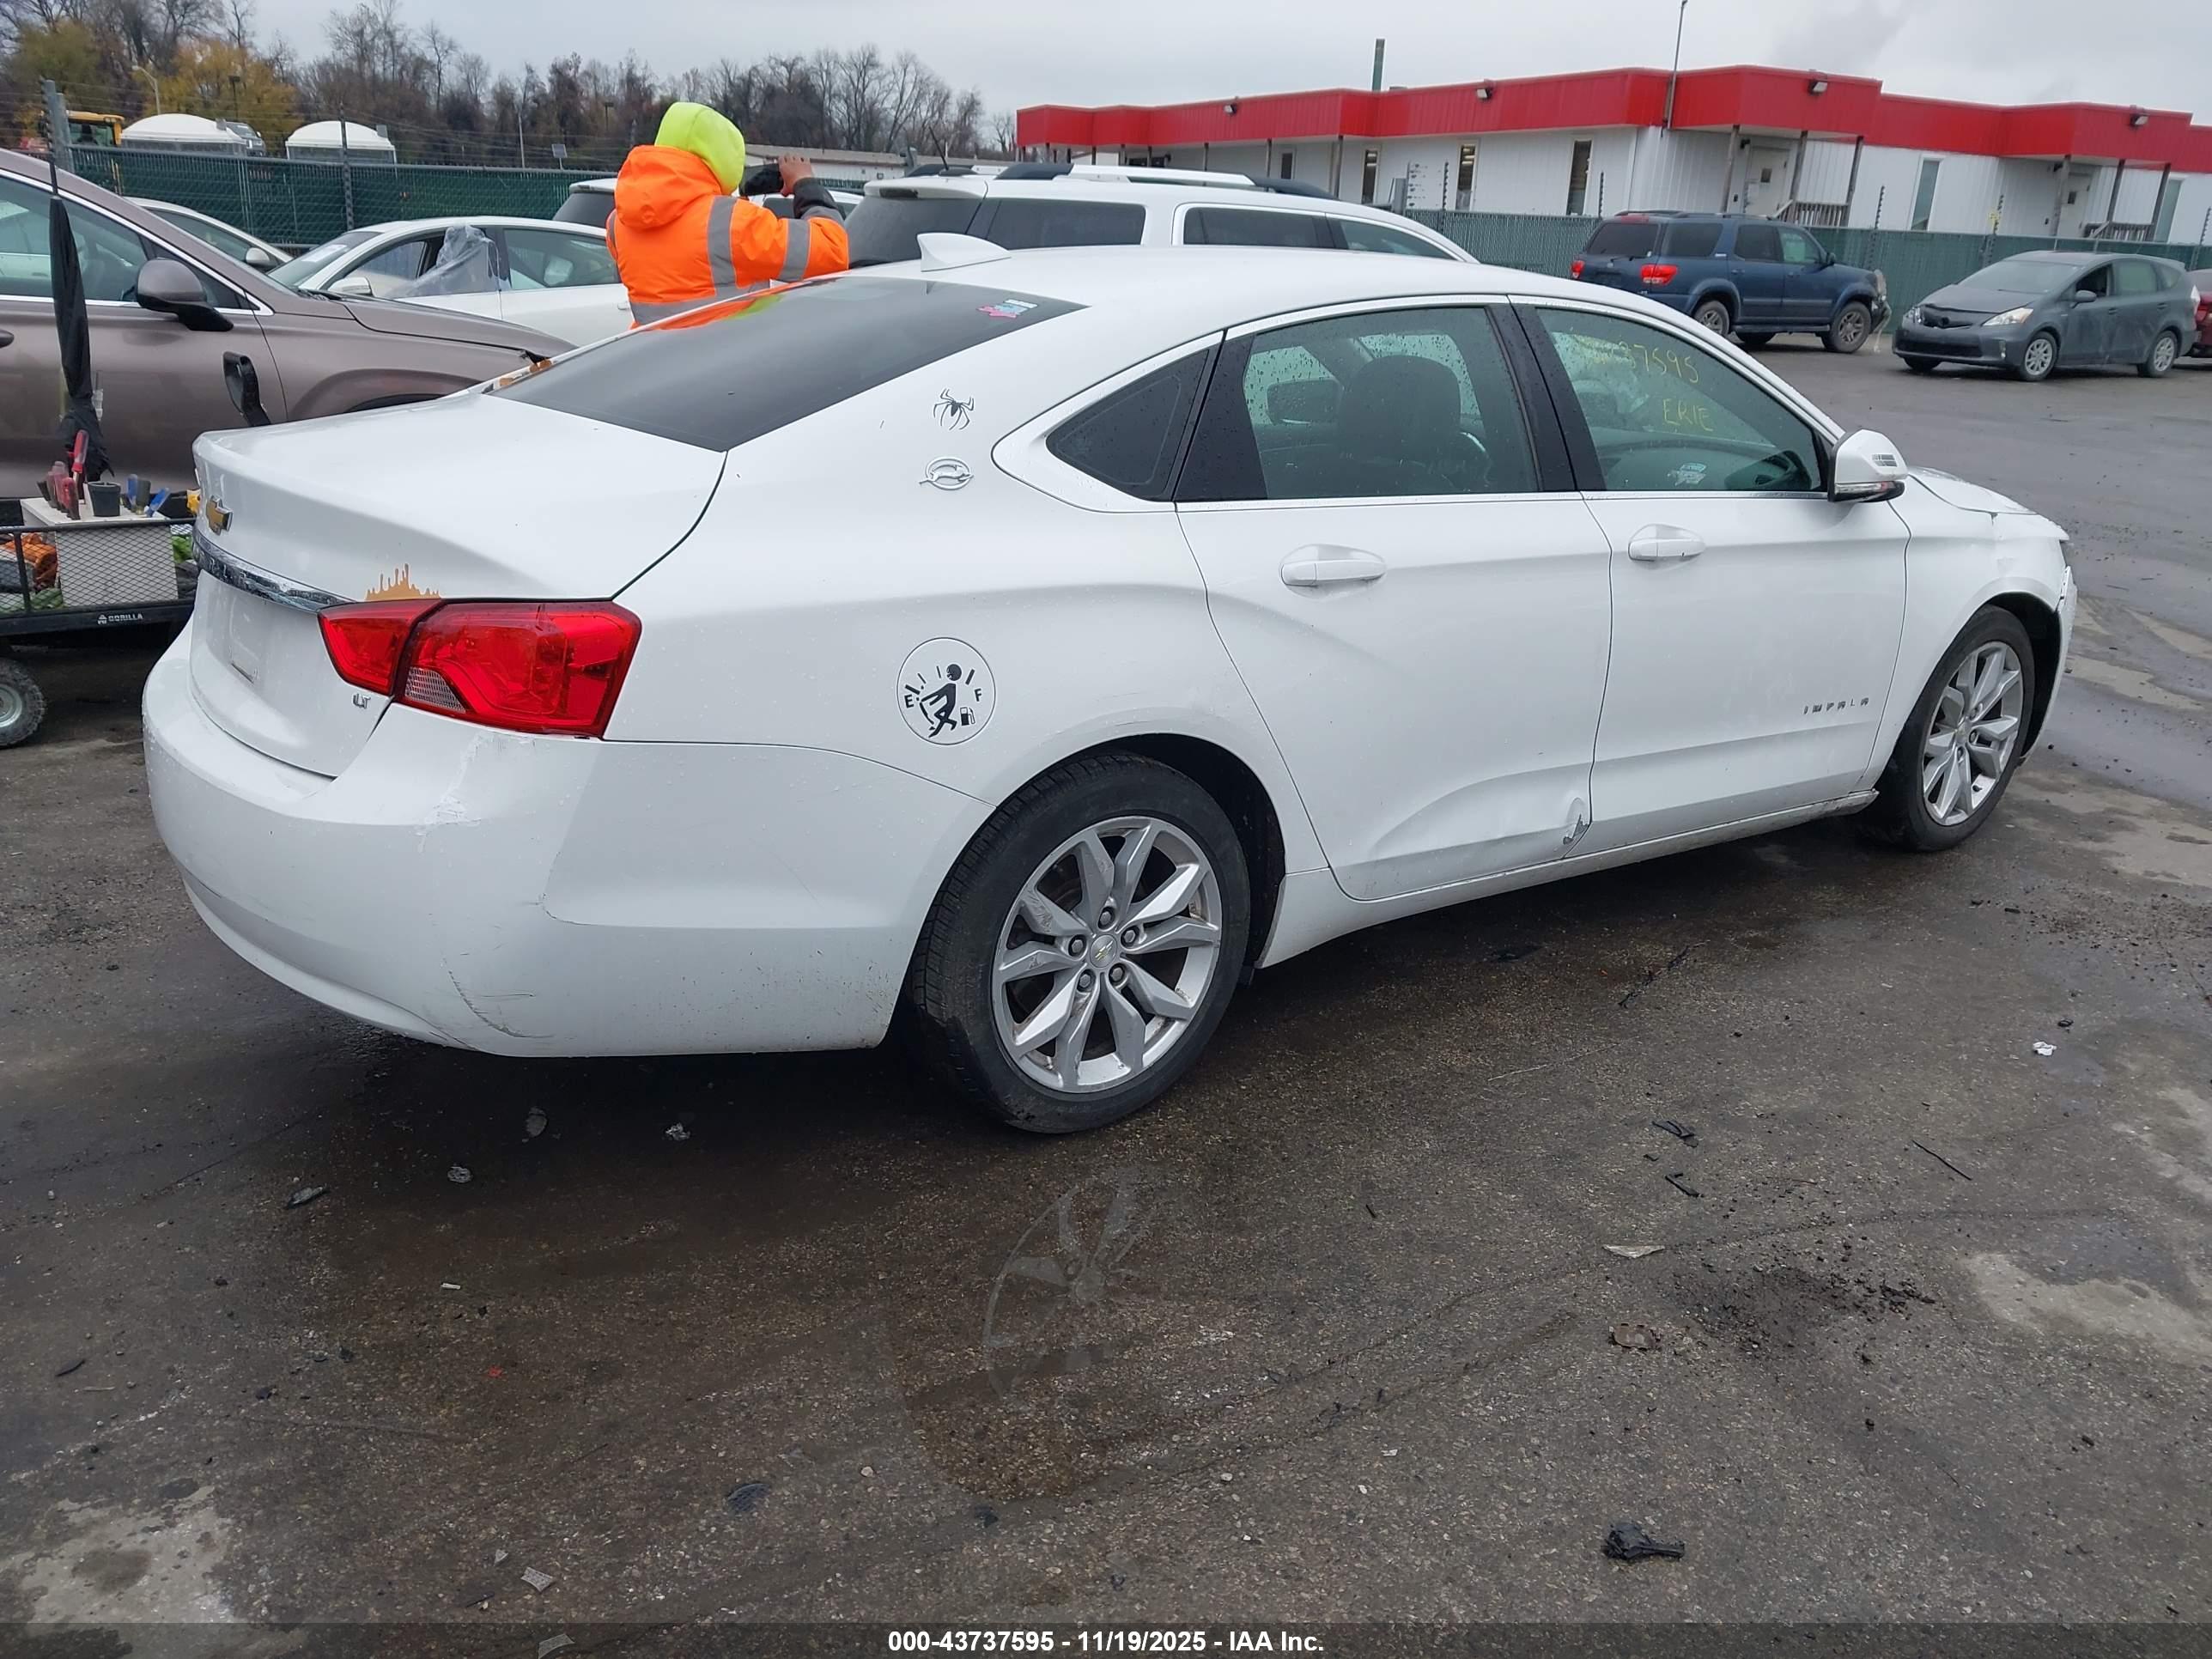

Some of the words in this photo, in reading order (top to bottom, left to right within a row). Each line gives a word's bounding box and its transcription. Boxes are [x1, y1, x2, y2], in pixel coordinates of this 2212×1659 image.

[1662, 398, 1715, 432] ERIE
[108, 613, 144, 622] GORILLA
[352, 693, 372, 709] LT
[904, 694, 915, 708] E
[974, 688, 982, 702] F
[1803, 696, 1869, 715] IMPALA
